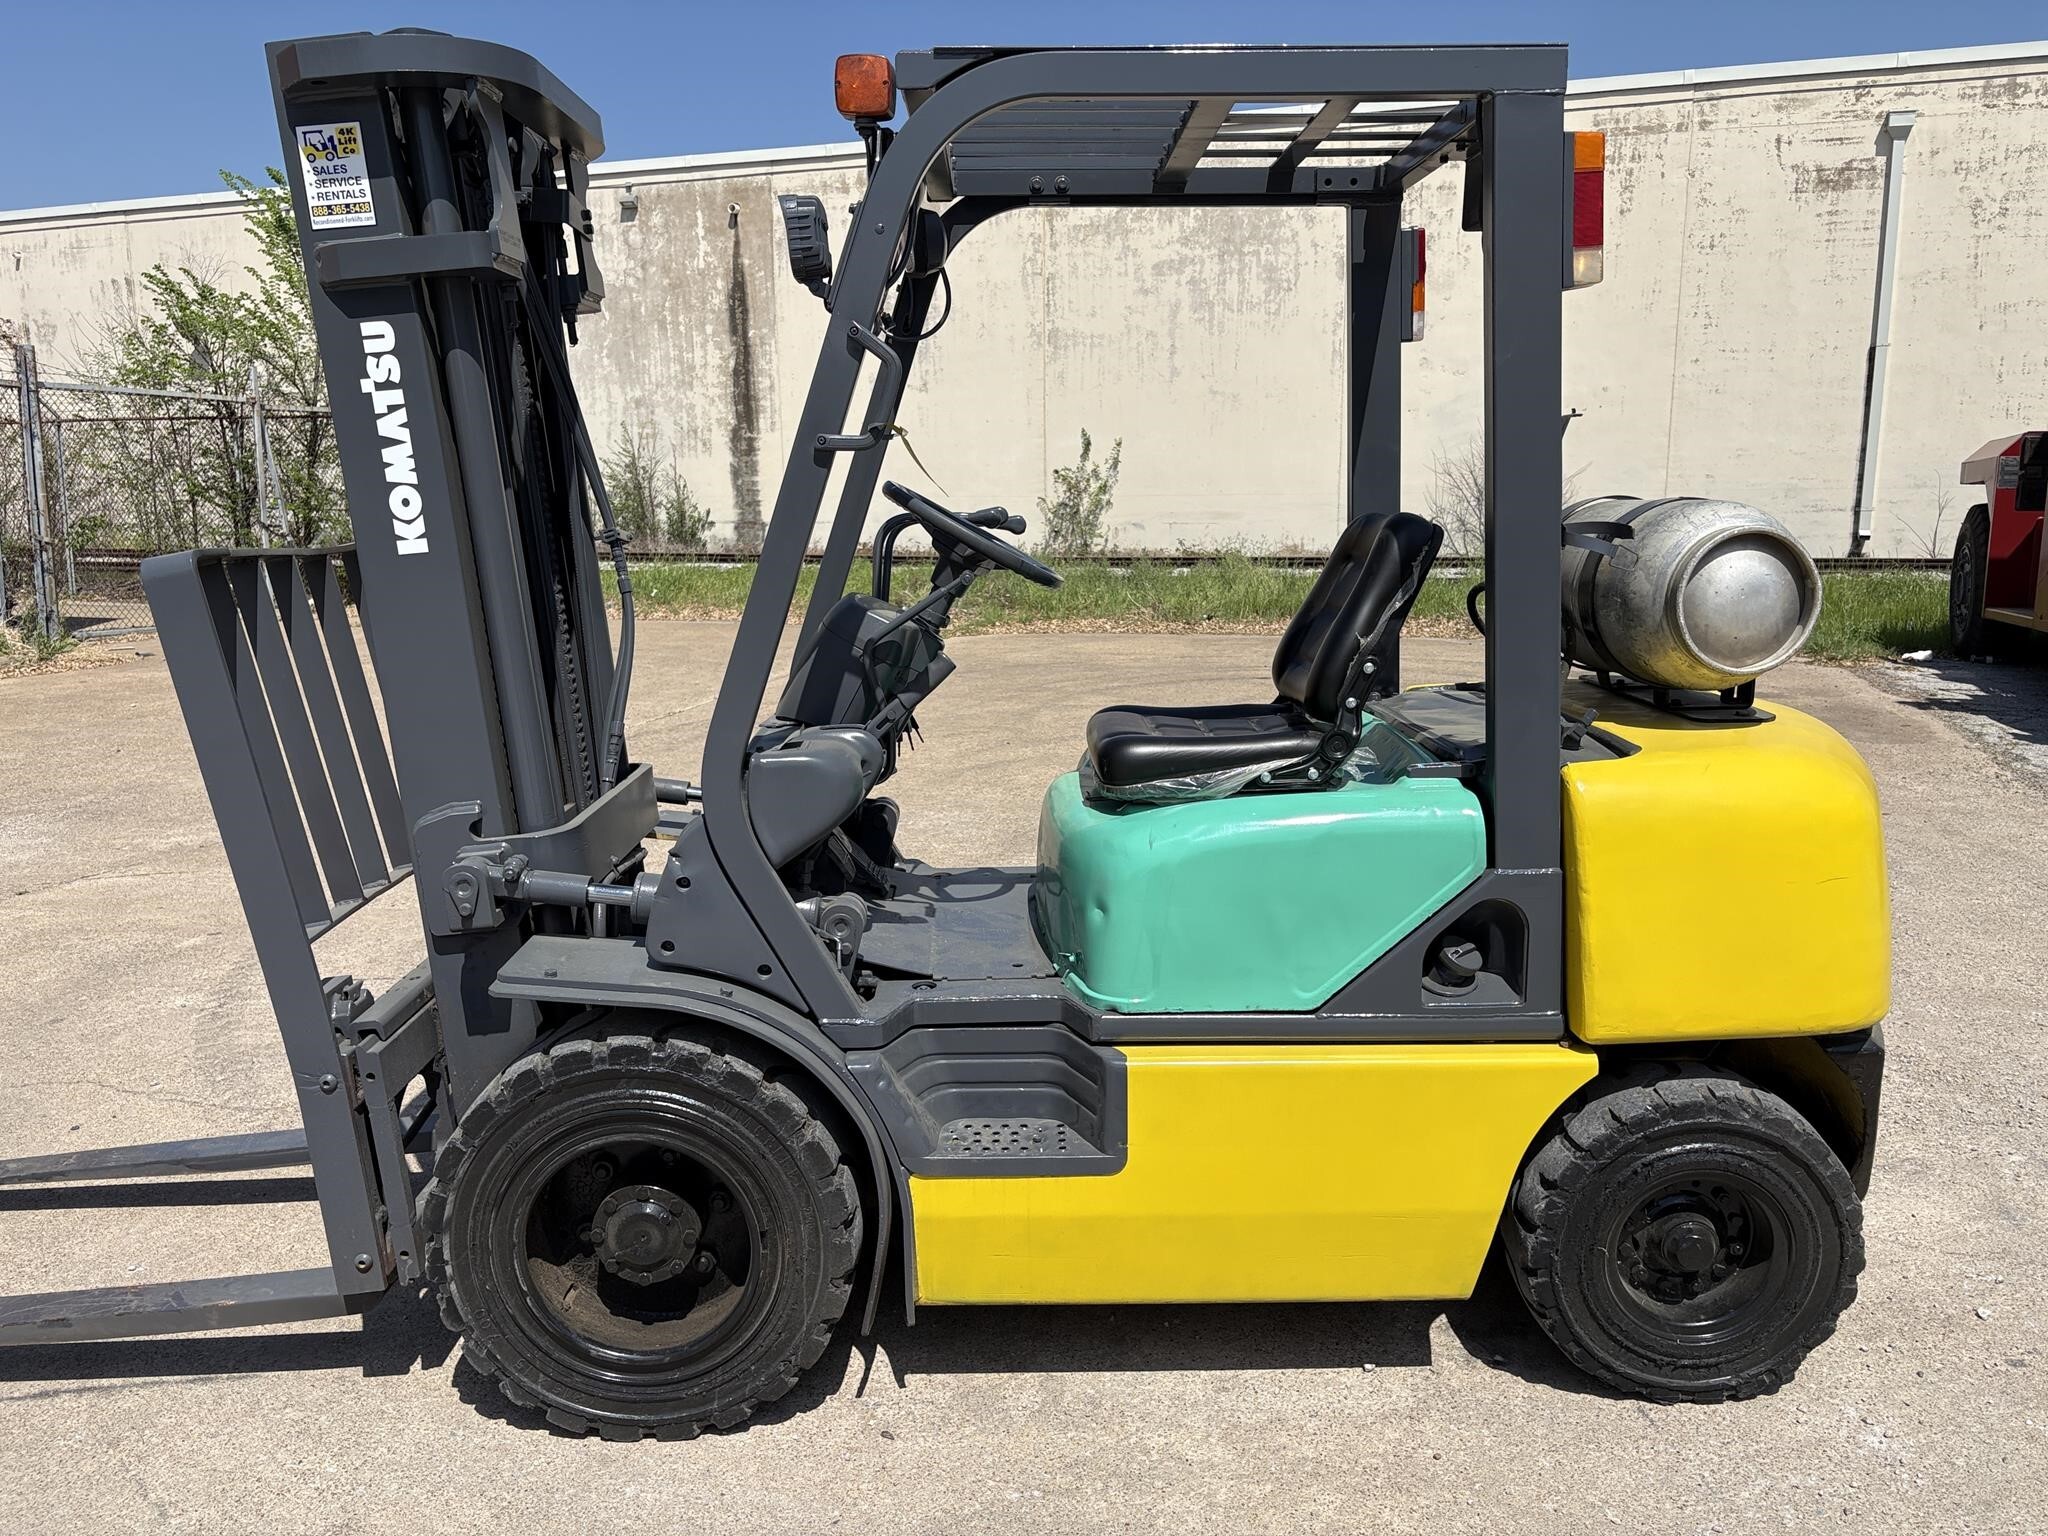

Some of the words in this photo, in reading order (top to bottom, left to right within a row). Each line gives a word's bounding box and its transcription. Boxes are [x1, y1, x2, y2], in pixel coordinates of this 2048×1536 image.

[338, 128, 355, 136] 4K
[338, 137, 357, 146] Lift
[312, 164, 348, 176] SALES
[314, 176, 362, 189] SERVICE
[317, 189, 367, 202] RENTALS
[312, 203, 371, 217] 888-365-5438
[359, 320, 430, 556] KOMATSU
